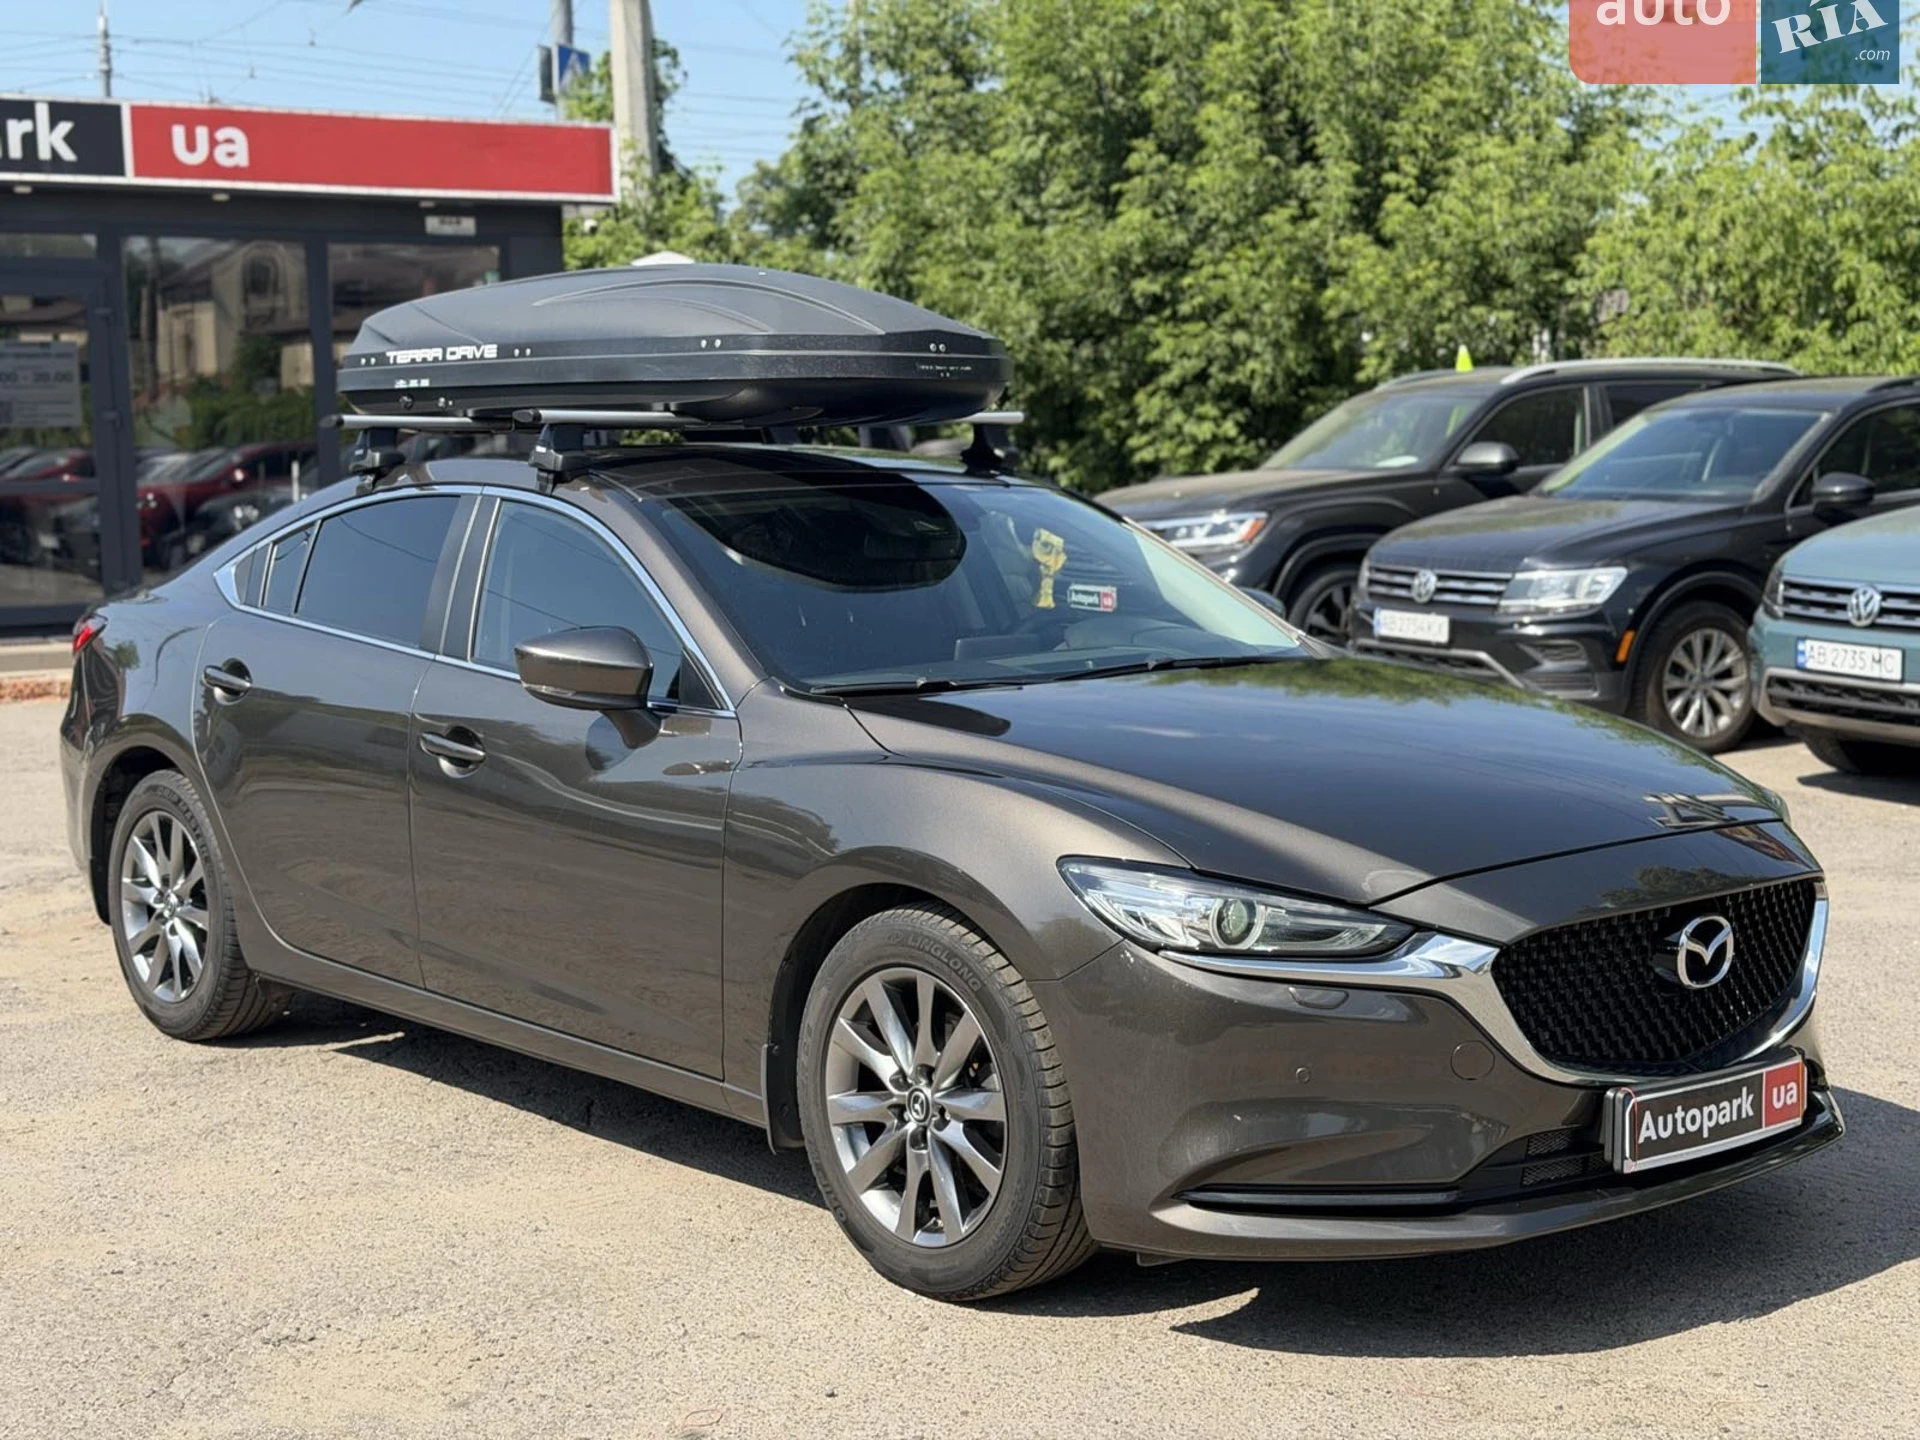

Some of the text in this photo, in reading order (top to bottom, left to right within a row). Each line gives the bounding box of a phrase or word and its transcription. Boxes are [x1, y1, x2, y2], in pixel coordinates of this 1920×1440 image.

[0, 102, 249, 168] rk ua
[446, 344, 498, 360] DRIVE
[1831, 648, 1867, 671] 2735
[907, 933, 983, 992] LINGLONG
[1638, 1082, 1798, 1144] Autopark ua
